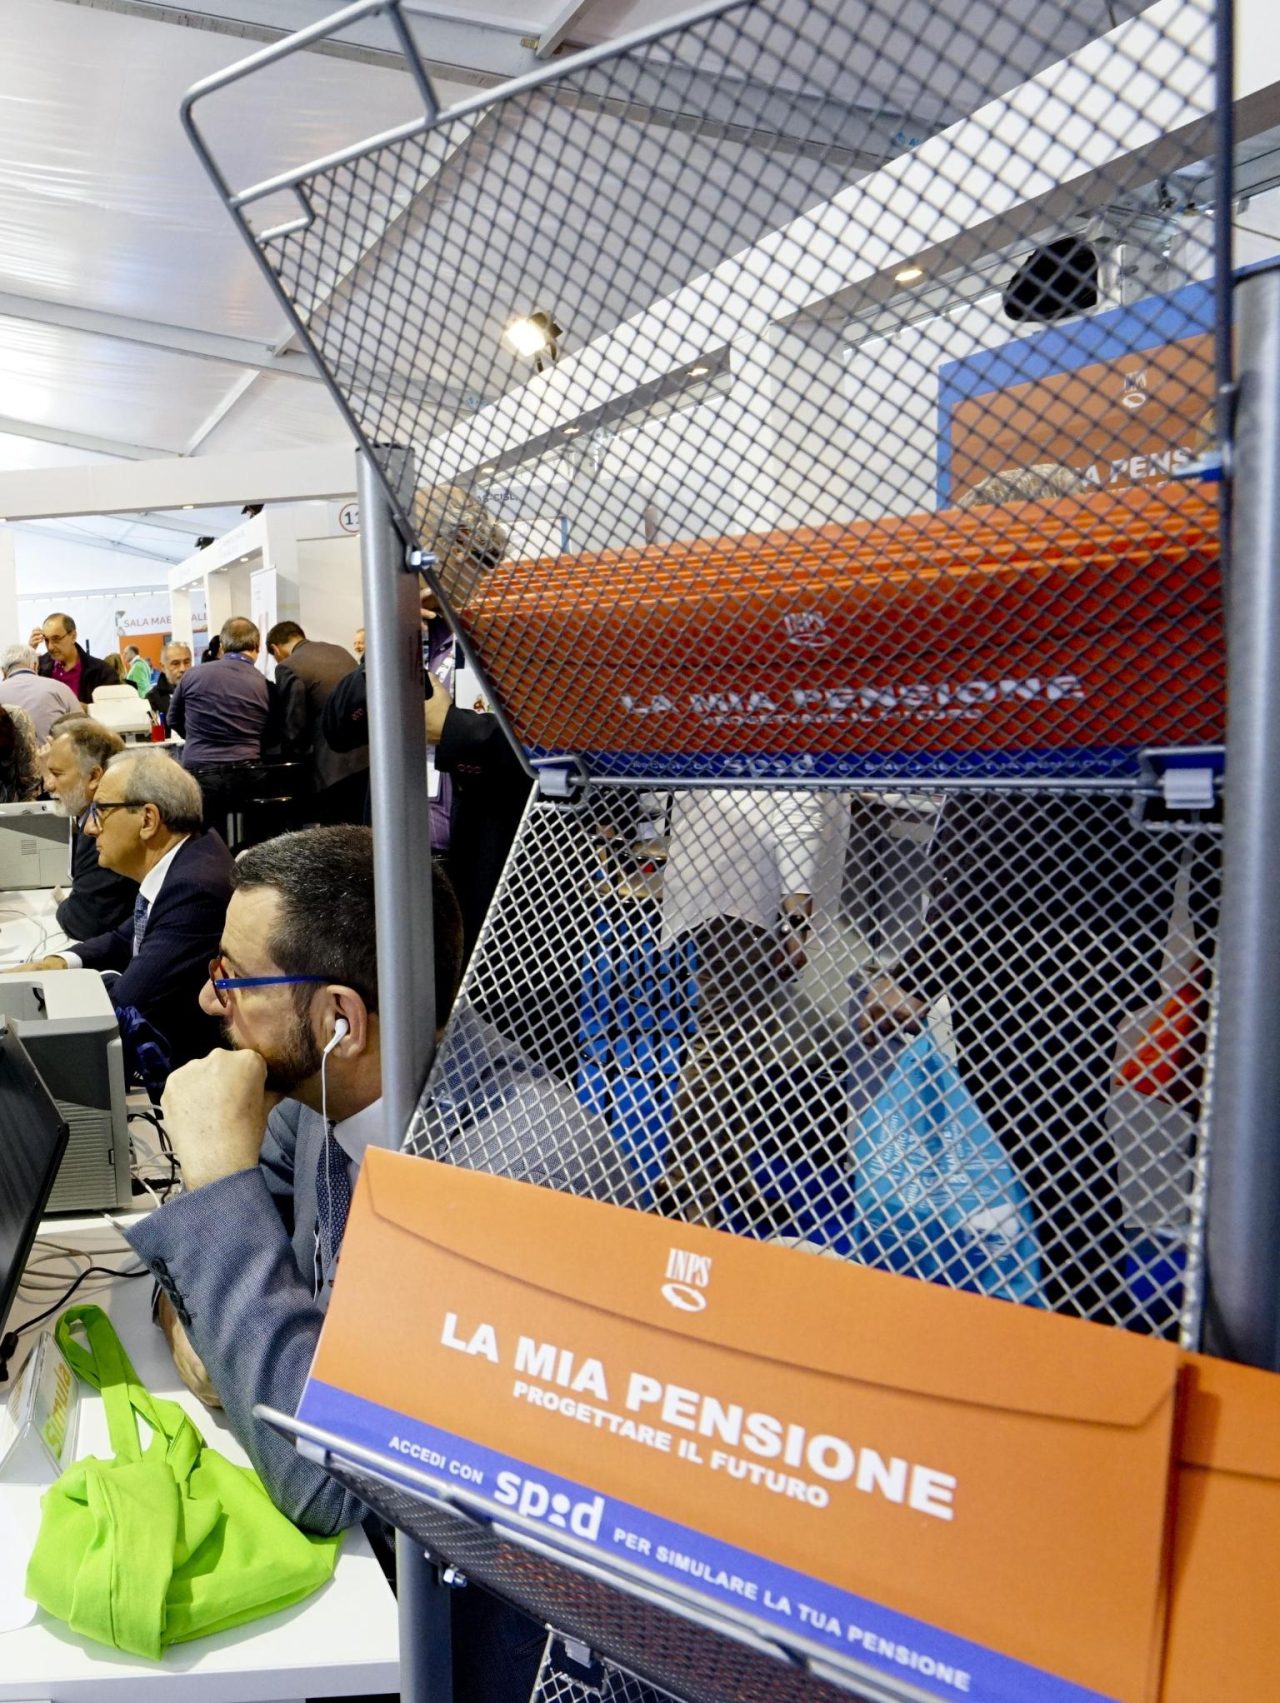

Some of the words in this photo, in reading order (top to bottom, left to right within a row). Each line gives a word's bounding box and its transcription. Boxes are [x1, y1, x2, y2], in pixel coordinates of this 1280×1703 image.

[1110, 447, 1192, 483] PENS
[124, 619, 148, 628] SALA
[151, 613, 208, 626] MAEALE
[622, 694, 677, 714] LA
[688, 692, 776, 713] MIA
[792, 674, 1085, 710] PENSIONE
[665, 1247, 712, 1289] INPS
[440, 1312, 499, 1364] LA
[514, 1335, 609, 1401] MIA
[625, 1372, 957, 1520] PENSIONE
[513, 1381, 671, 1452] PROGETTARE
[678, 1438, 703, 1465] IL
[711, 1450, 830, 1509] FUTURO
[388, 1436, 446, 1469] ACCEDI
[449, 1460, 484, 1485] CON
[613, 1528, 651, 1555] PER
[656, 1545, 758, 1601] SIMULARE
[763, 1590, 792, 1616] LA
[797, 1603, 843, 1637] TUA
[847, 1625, 972, 1692] PENSIONE
